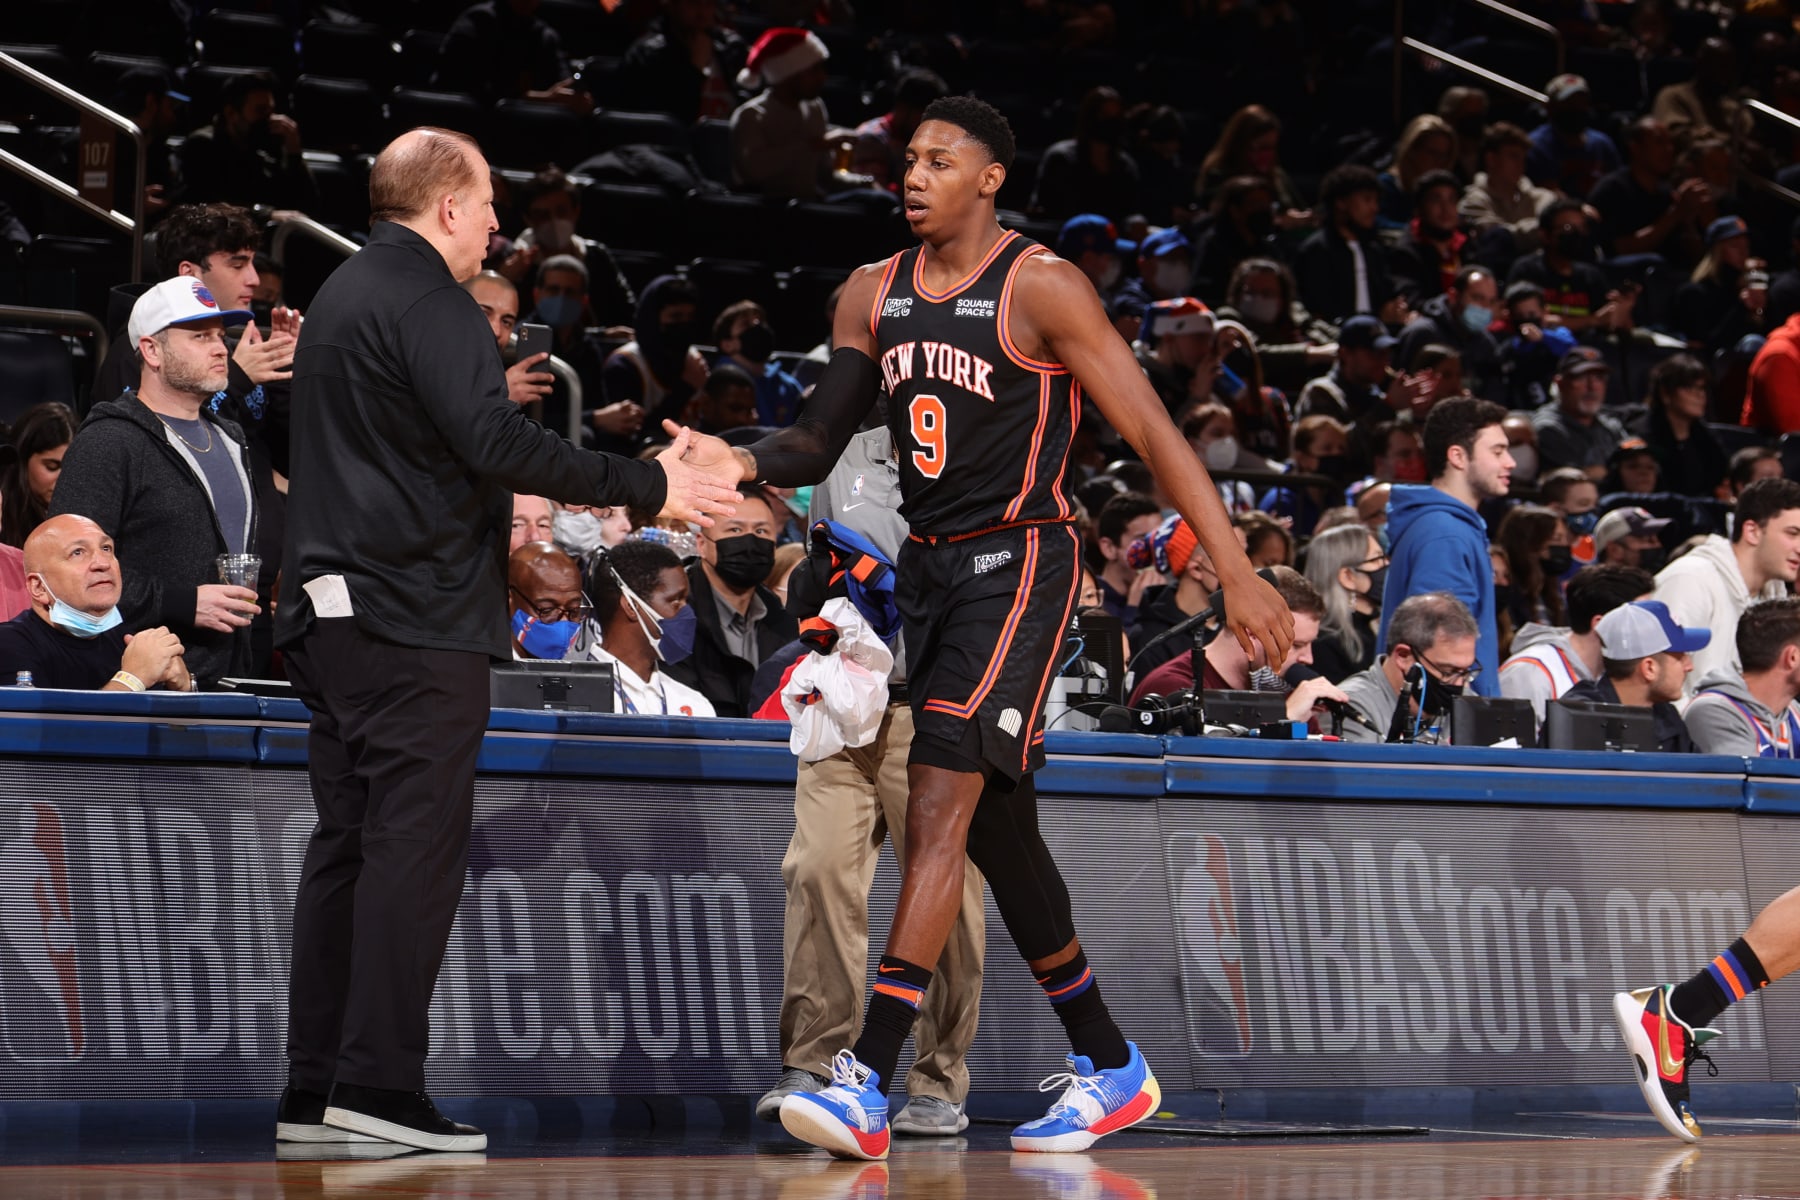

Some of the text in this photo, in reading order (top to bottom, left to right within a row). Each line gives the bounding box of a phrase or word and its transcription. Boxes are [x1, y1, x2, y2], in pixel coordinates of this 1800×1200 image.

[84, 142, 110, 166] 107
[955, 307, 986, 317] SPACE
[957, 299, 996, 309] SQUARE
[880, 341, 995, 402] NEW YORK
[908, 394, 947, 479] 9
